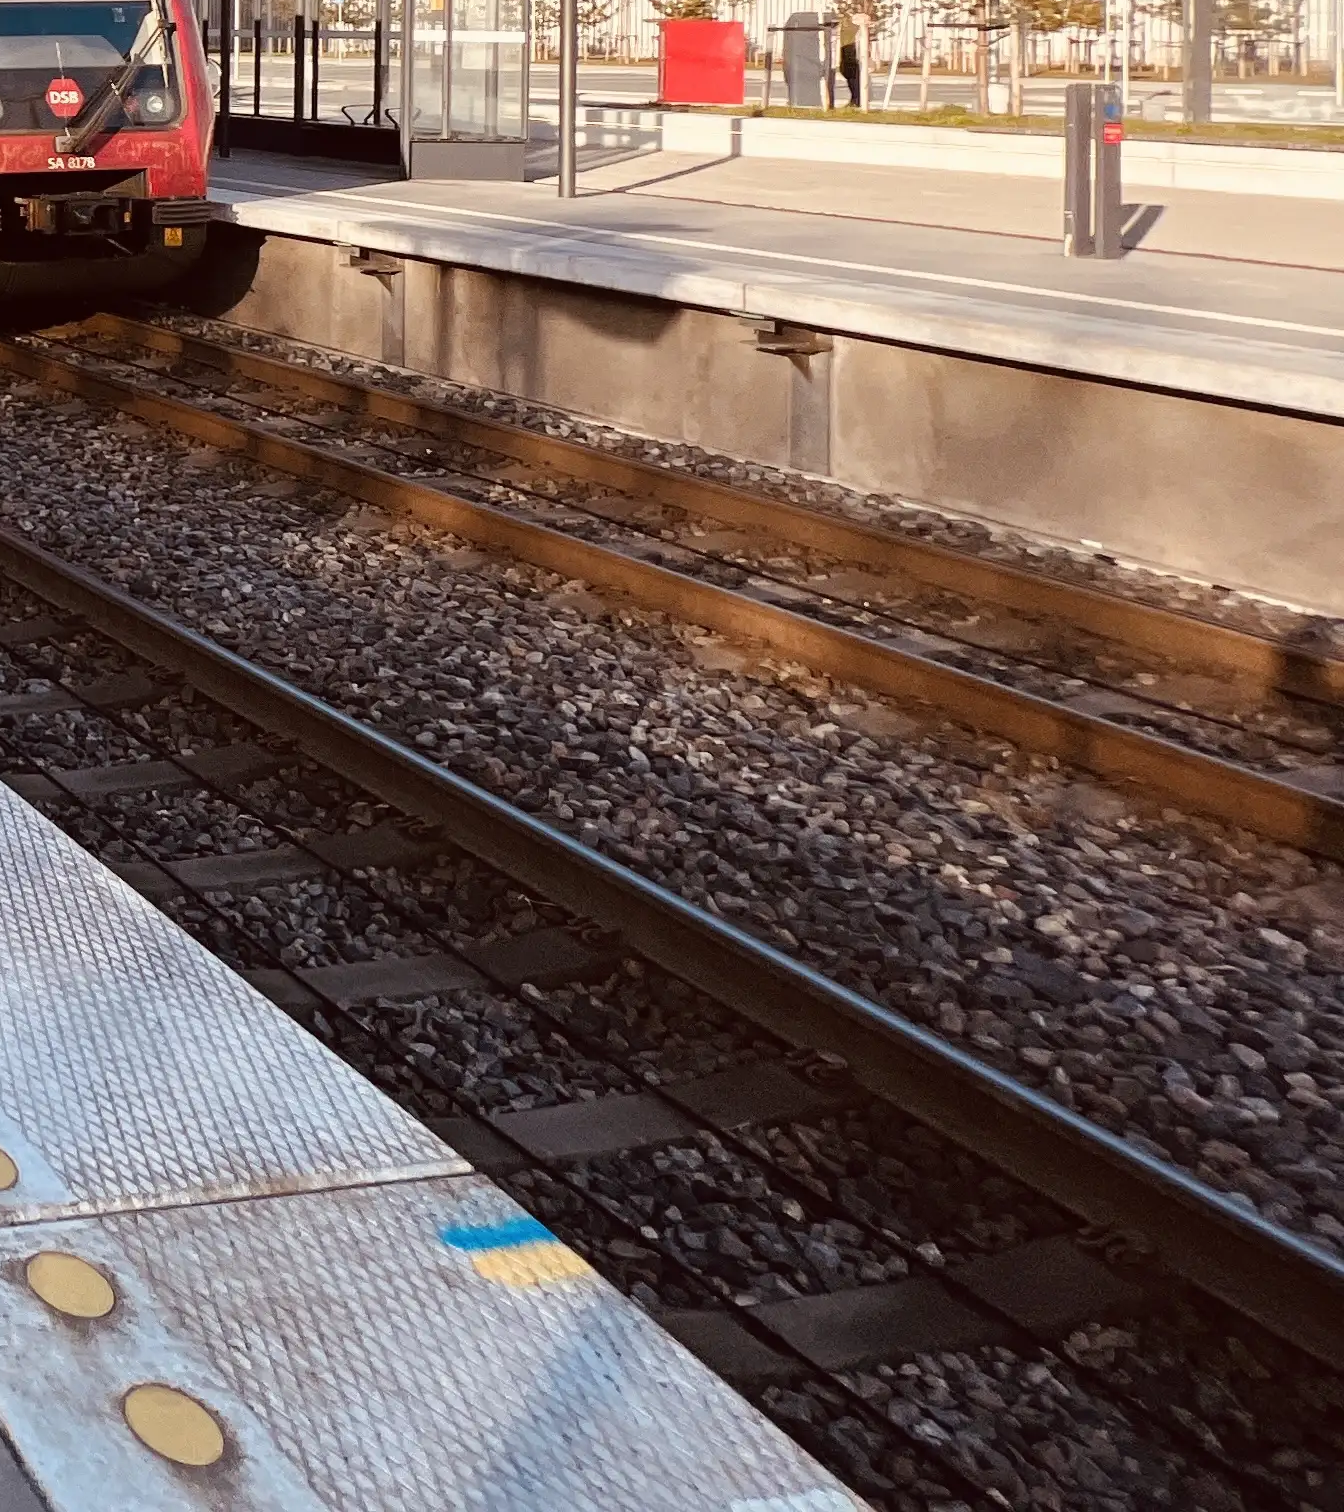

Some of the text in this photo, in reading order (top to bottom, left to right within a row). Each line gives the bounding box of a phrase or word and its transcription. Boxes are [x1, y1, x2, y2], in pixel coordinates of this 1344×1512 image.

[49, 91, 80, 104] DSB
[47, 156, 96, 170] SA 8178
